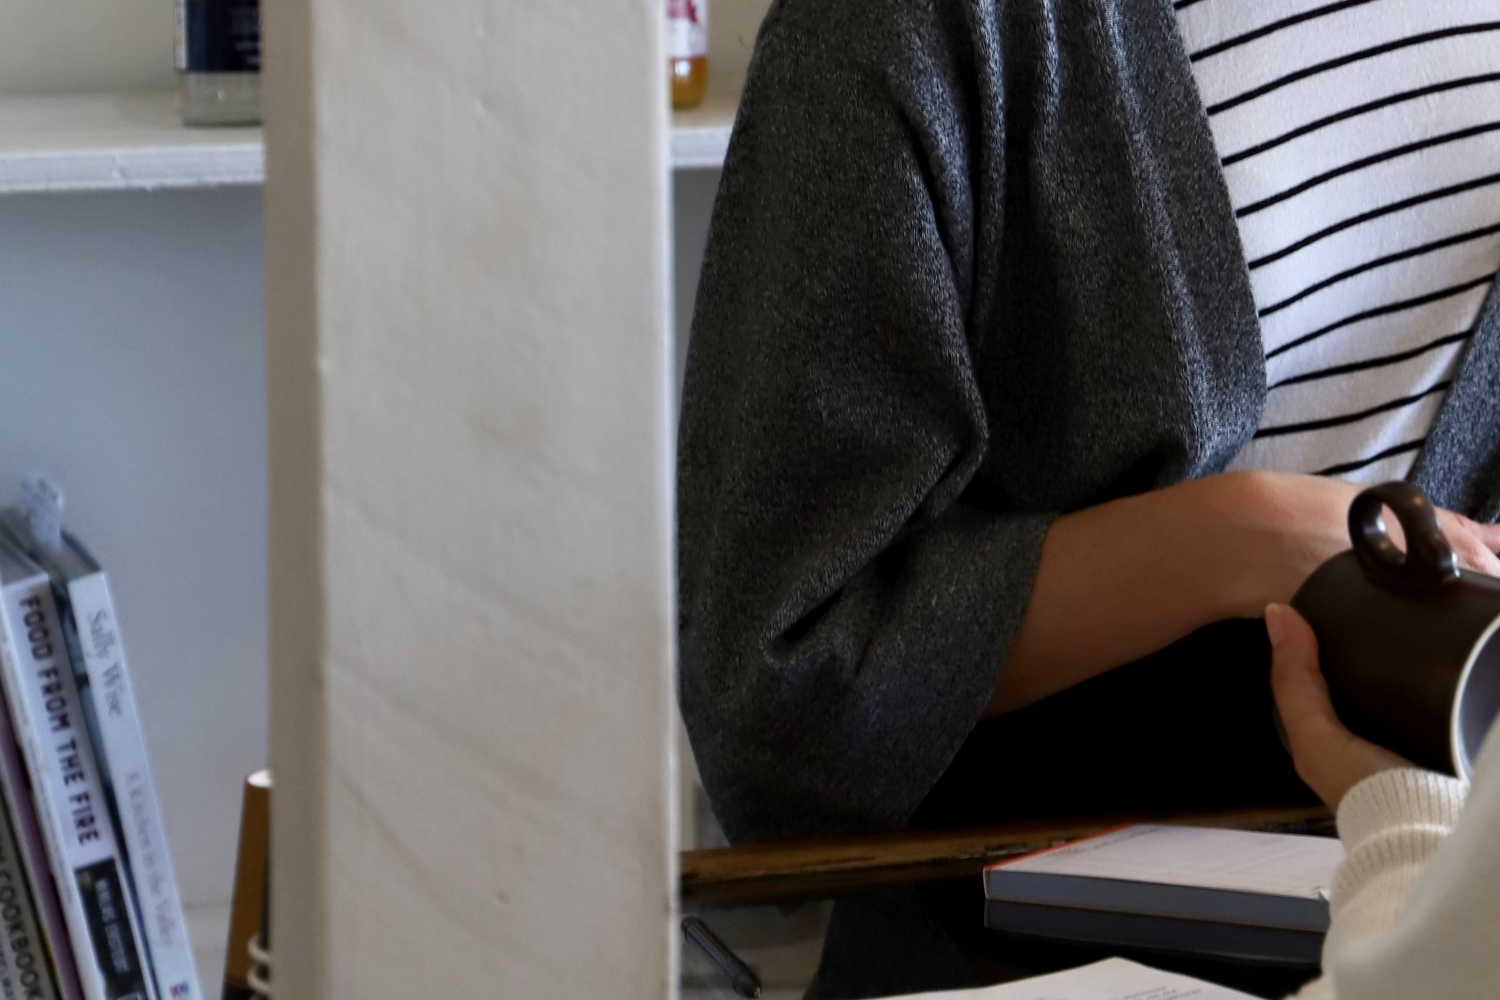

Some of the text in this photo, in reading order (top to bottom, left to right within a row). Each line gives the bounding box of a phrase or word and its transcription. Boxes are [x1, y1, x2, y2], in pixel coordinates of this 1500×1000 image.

[18, 595, 99, 846] FOOD FROM THE FIRE
